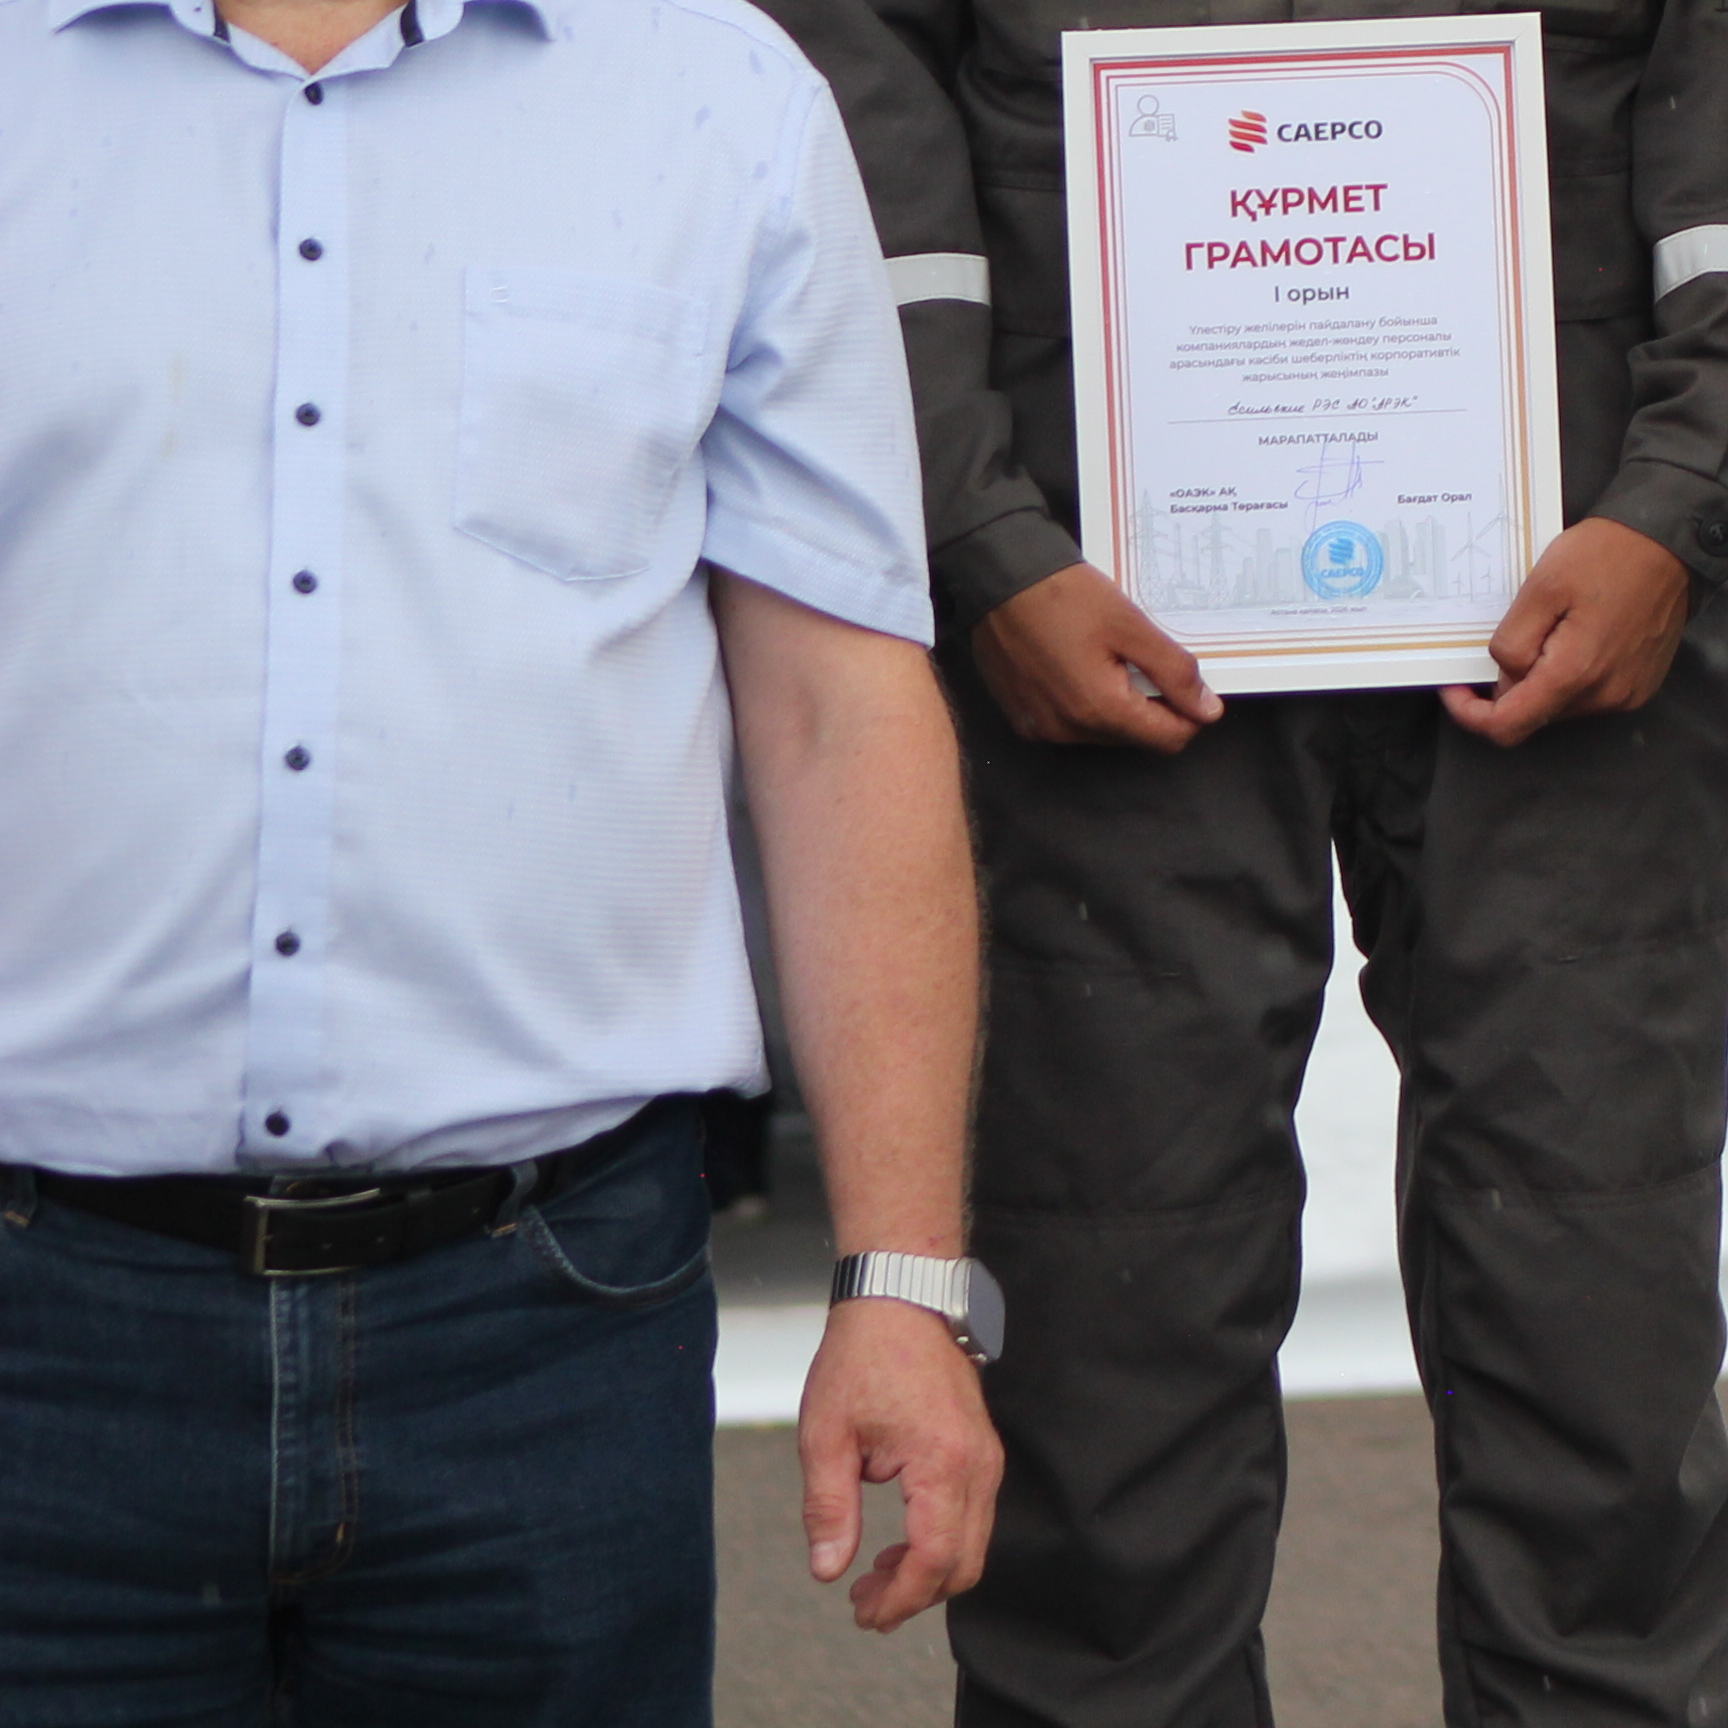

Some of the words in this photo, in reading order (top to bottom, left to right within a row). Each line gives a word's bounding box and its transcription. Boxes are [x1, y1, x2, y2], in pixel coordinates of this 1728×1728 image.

[1276, 120, 1384, 143] CAEPCO
[1230, 183, 1389, 223] ҚҰРМЕТ
[1184, 232, 1437, 271] ГРАМОТАСЫ
[1287, 285, 1351, 306] орын
[1258, 430, 1379, 447] МАРАПАТТАЛАДЫ
[1440, 491, 1472, 505] Орал
